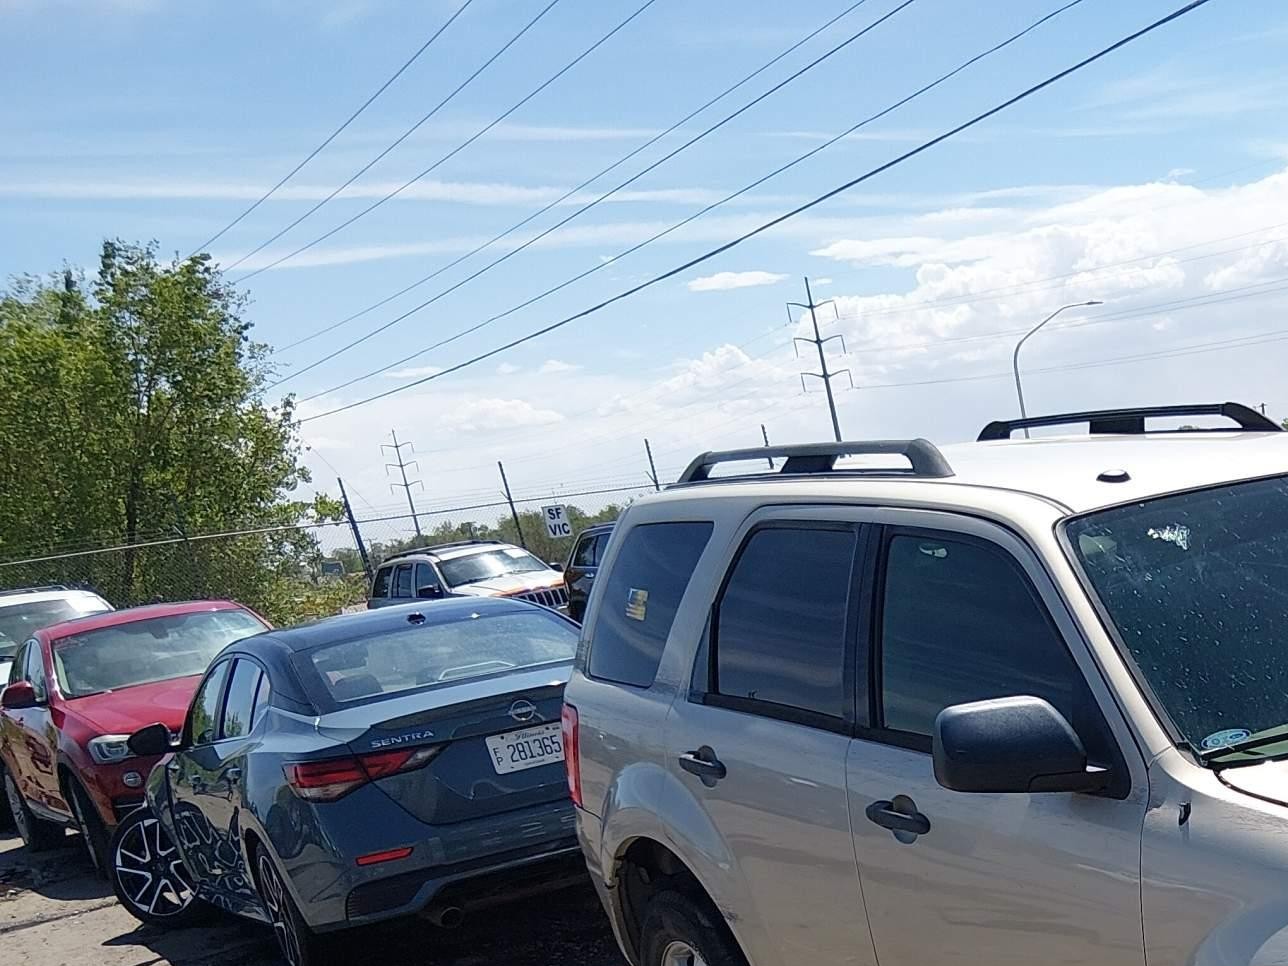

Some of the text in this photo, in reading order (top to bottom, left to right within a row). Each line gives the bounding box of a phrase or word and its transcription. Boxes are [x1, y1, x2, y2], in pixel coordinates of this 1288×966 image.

[547, 507, 562, 520] SF
[548, 522, 570, 536] VIC
[371, 730, 434, 748] SENTRA
[506, 734, 562, 763] 281365
